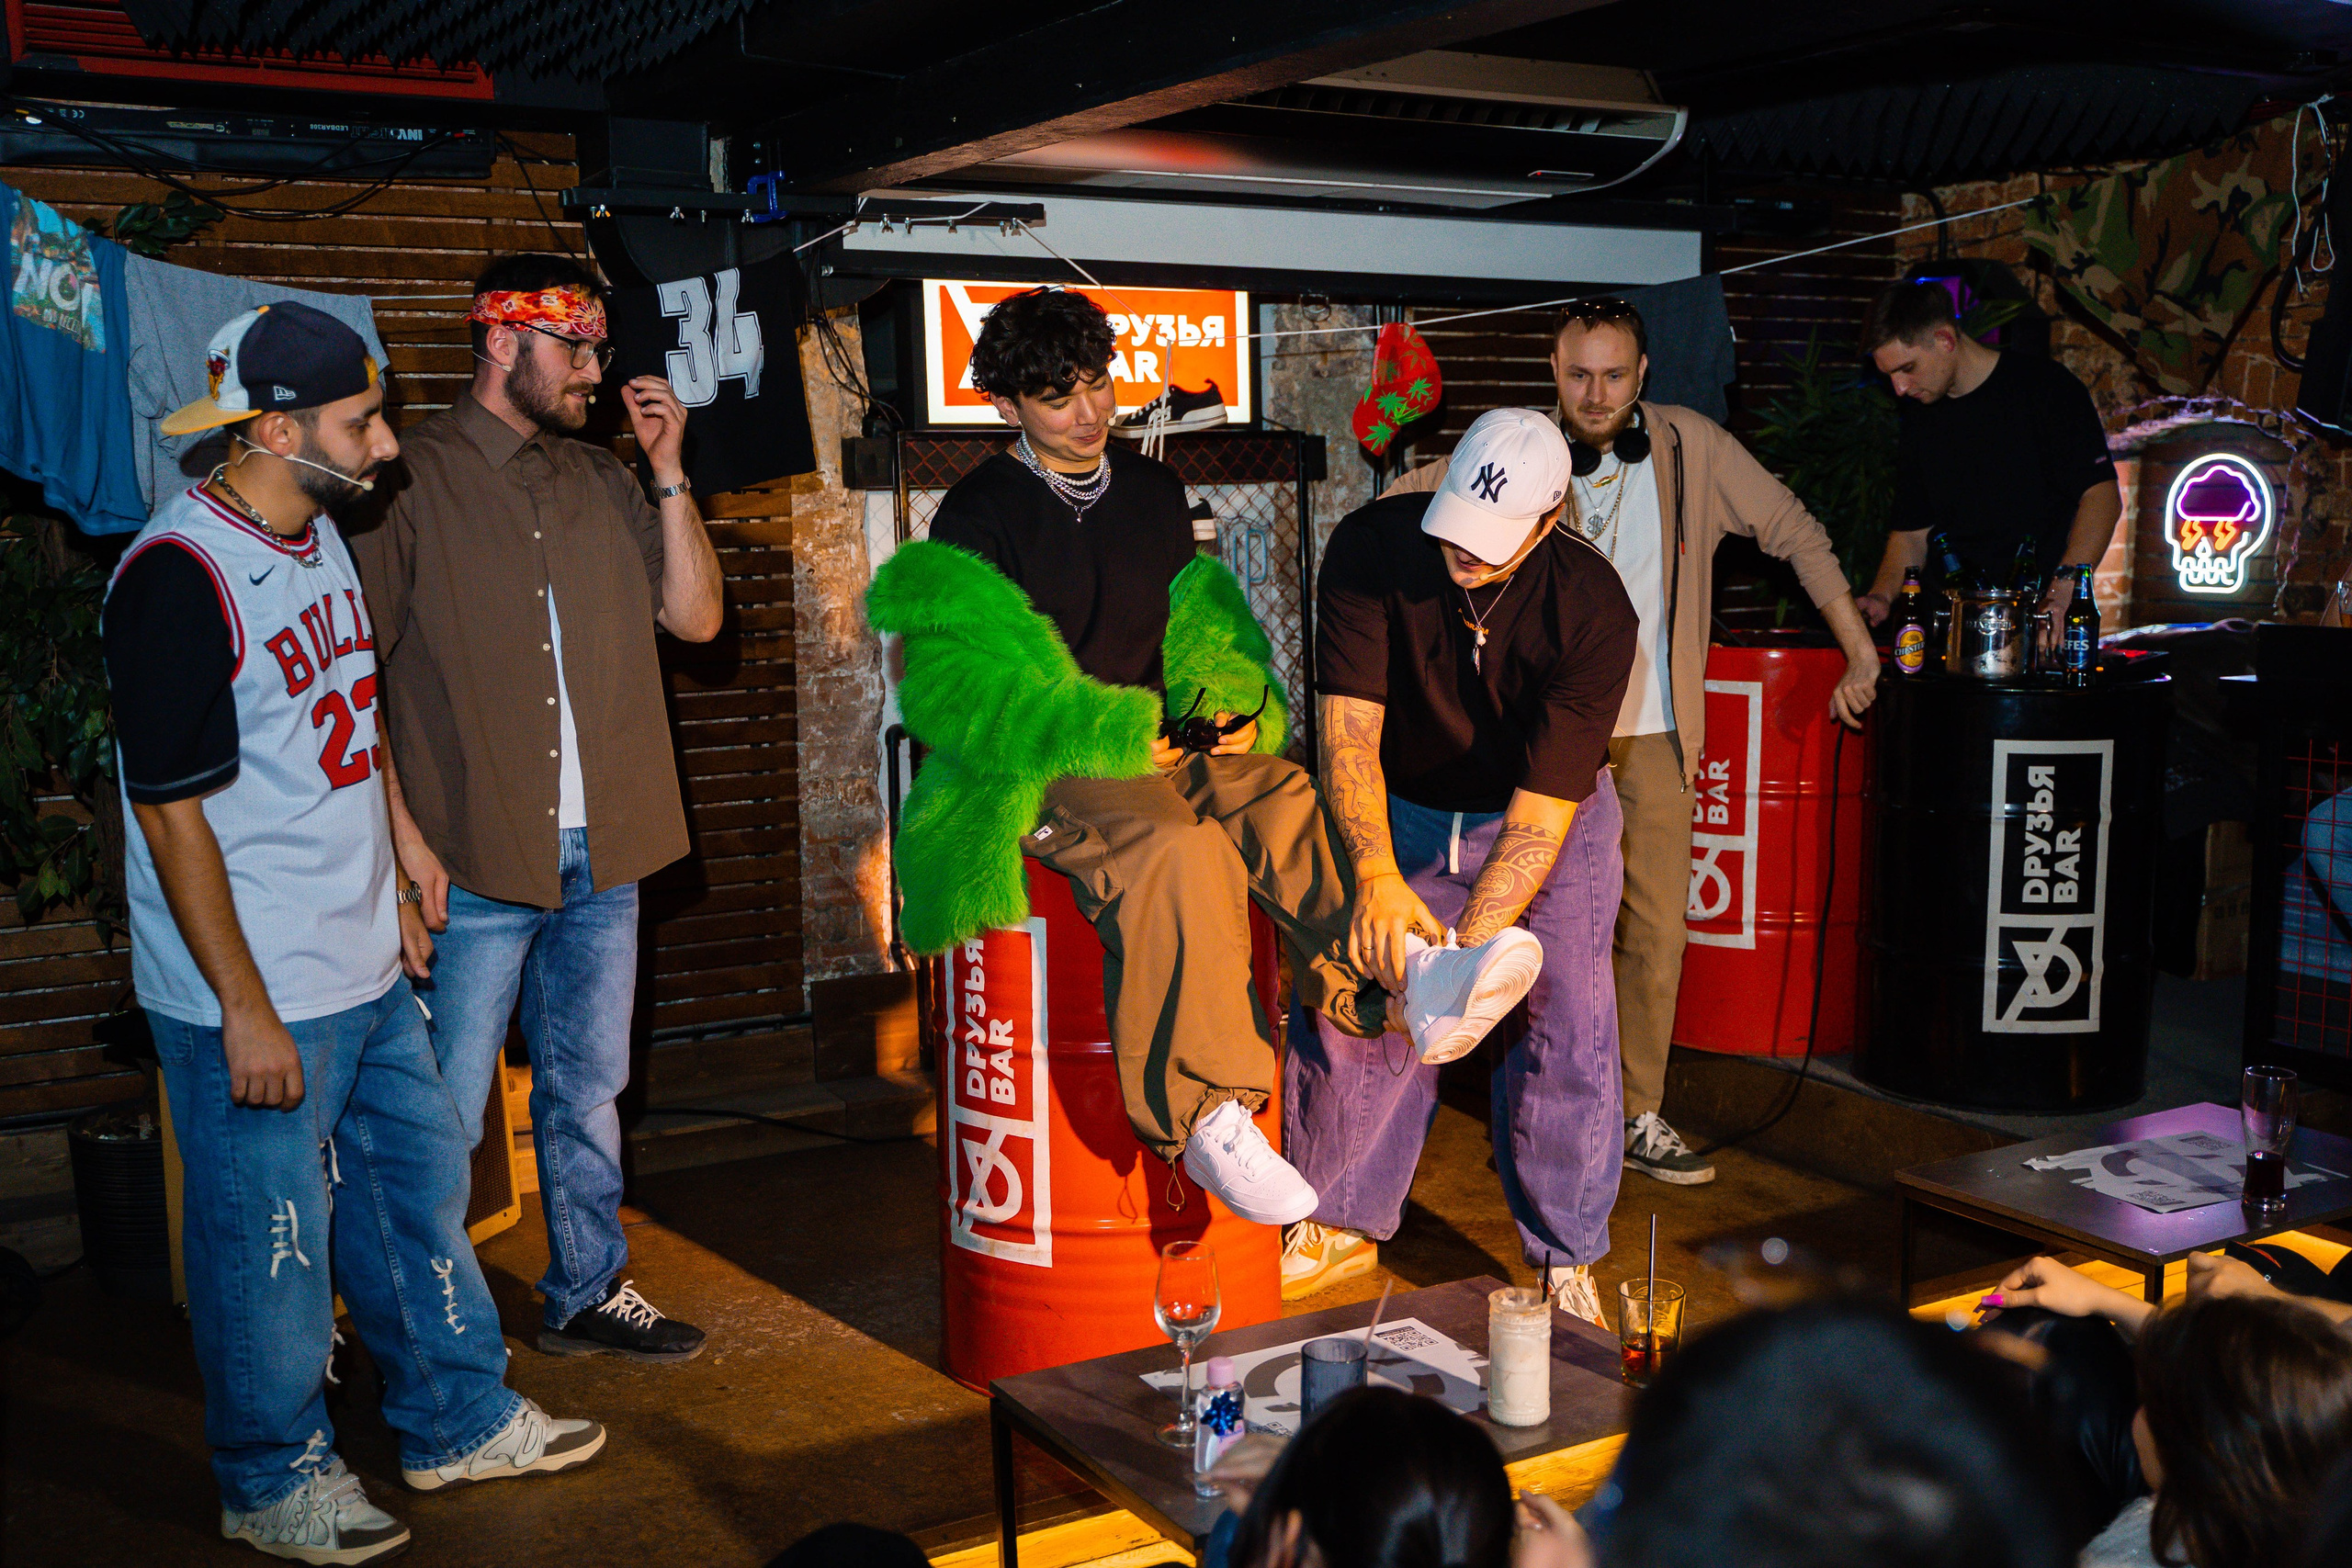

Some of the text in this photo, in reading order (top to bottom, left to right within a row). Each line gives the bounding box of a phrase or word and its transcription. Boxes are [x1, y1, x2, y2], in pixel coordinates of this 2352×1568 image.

[656, 267, 764, 408] 34
[1106, 313, 1226, 348] РУЗЬЯ
[1107, 350, 1162, 383] AR
[264, 589, 376, 699] BULL
[1707, 759, 1730, 825] BAR
[2052, 828, 2082, 903] BAR
[988, 1019, 1016, 1106] BAR
